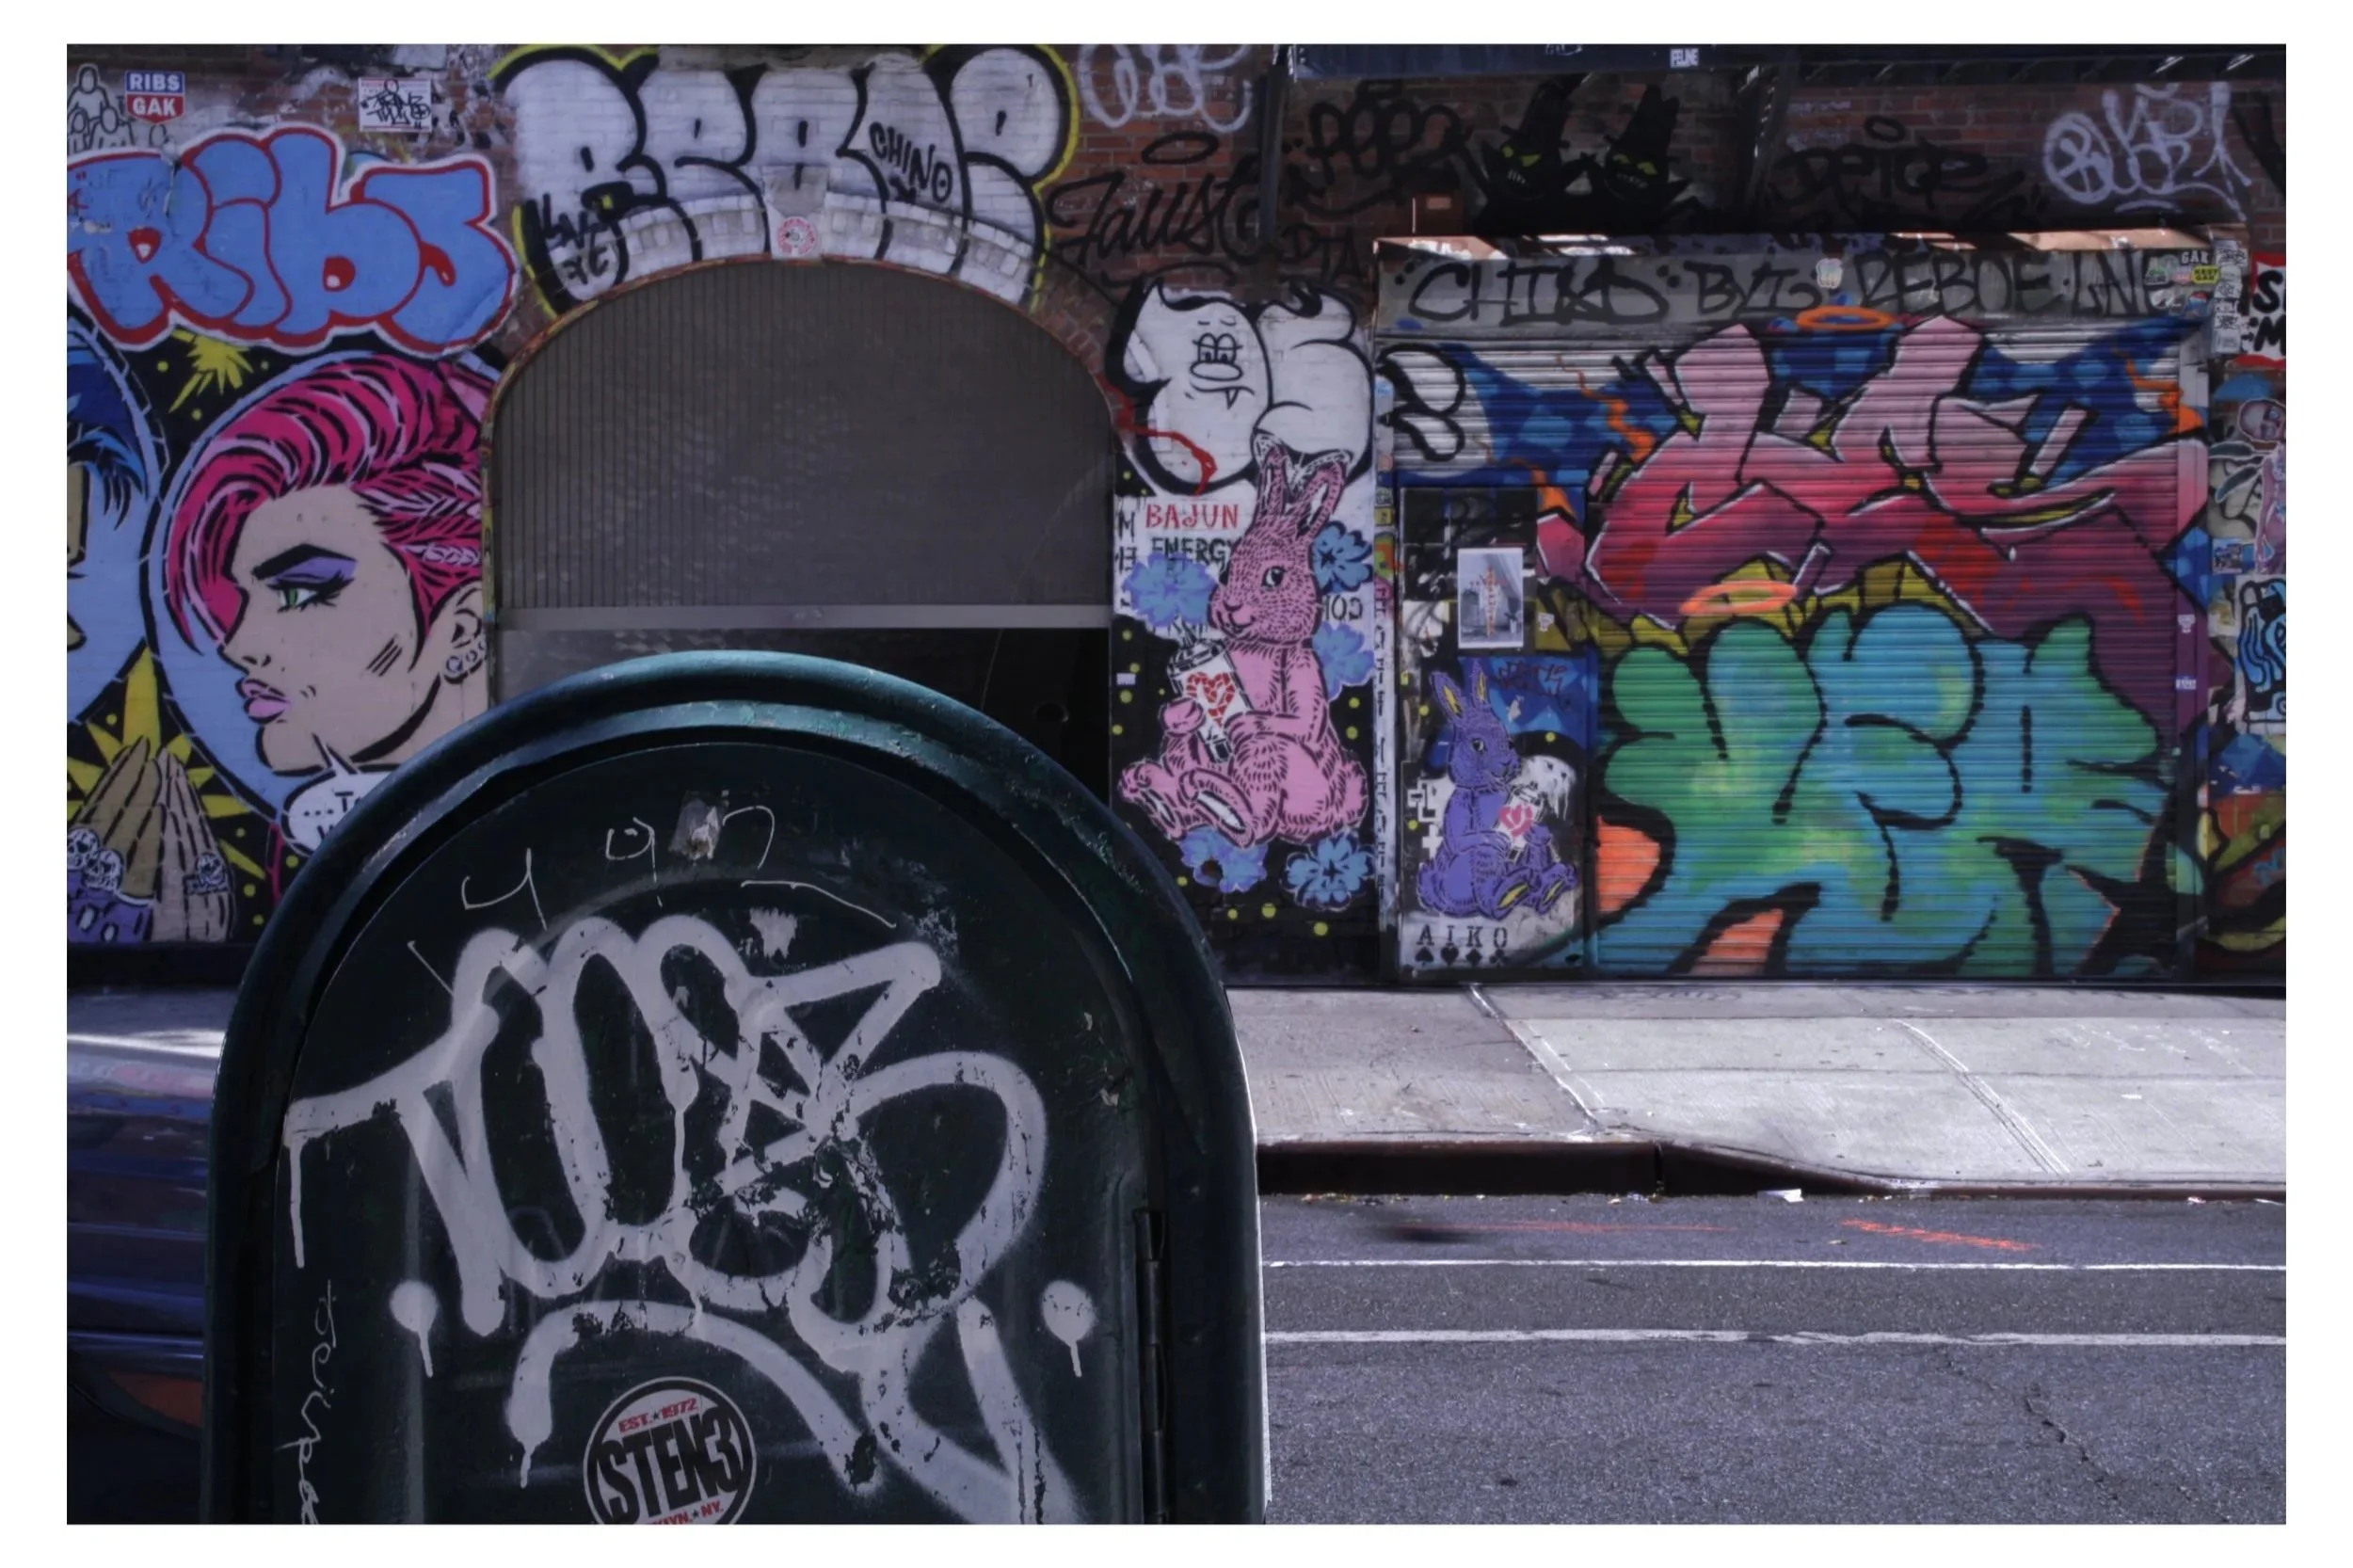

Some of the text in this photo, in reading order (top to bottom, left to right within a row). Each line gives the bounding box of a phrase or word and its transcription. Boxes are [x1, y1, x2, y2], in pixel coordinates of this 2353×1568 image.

[129, 72, 181, 91] RIBS
[132, 96, 177, 117] GAK
[869, 121, 953, 203] CHINO
[617, 1397, 699, 1432] EST. 1972
